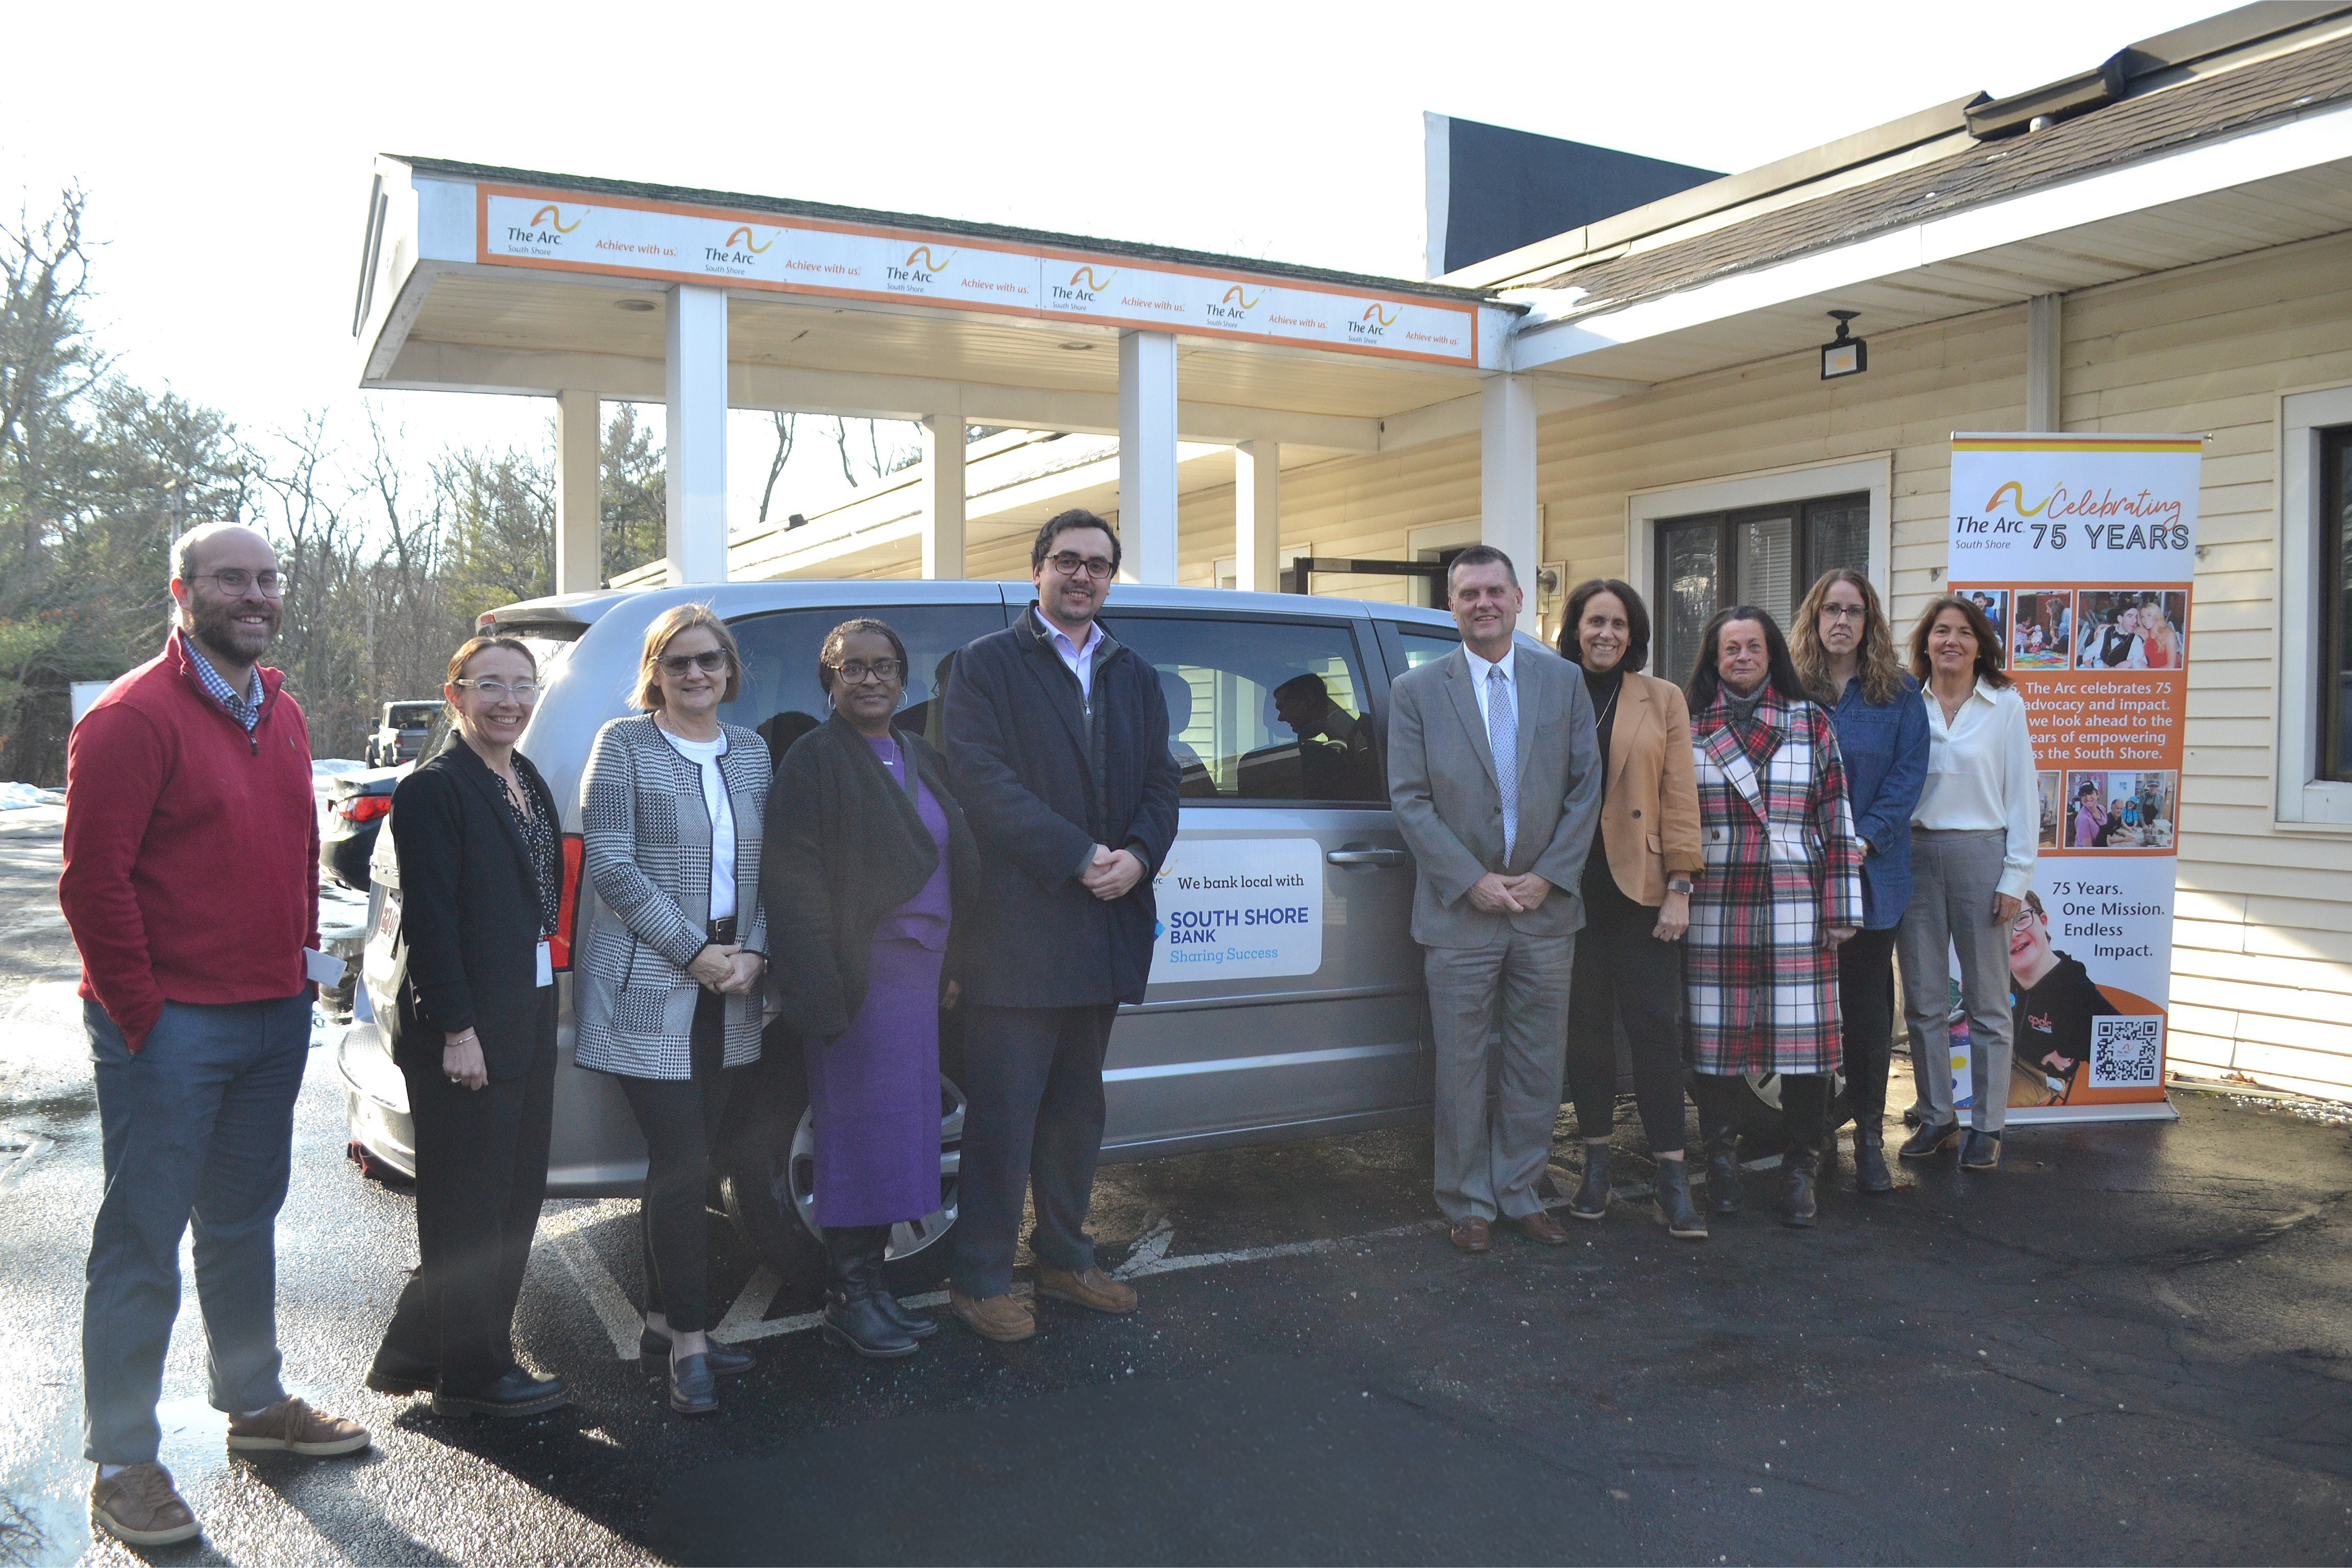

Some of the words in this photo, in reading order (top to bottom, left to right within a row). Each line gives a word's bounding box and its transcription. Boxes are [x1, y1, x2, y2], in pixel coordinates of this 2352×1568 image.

[507, 227, 534, 242] The
[508, 245, 528, 254] South
[531, 247, 551, 255] Shore
[596, 239, 634, 253] Achieve
[638, 243, 660, 255] with
[705, 248, 729, 262] The
[705, 264, 724, 273] South
[726, 266, 745, 275] Shore
[785, 259, 822, 272] Achieve
[824, 263, 846, 274] with
[887, 267, 909, 280] The
[906, 284, 924, 292] Shore
[961, 278, 994, 289] Achieve
[996, 281, 1016, 291] with
[1052, 286, 1072, 299] The
[1121, 297, 1152, 308] Achieve
[1154, 300, 1172, 310] with
[1207, 304, 1225, 316] The
[1269, 314, 1297, 326] Achieve
[1299, 318, 1316, 327] with
[1348, 321, 1365, 333] The
[1406, 331, 1431, 342] Achieve
[1433, 334, 1448, 344] with
[2047, 488, 2182, 532] Celebrating
[1956, 516, 1989, 533] The
[2030, 524, 2067, 549] 75
[2085, 524, 2189, 549] YEARS
[1956, 540, 1983, 549] South
[1985, 540, 2011, 549] Shore
[2026, 682, 2050, 694] The
[2054, 683, 2076, 694] Arc
[2080, 682, 2151, 694] celebrates
[2156, 682, 2171, 693] 75
[2024, 698, 2084, 713] advocacy
[2089, 699, 2115, 710] and
[2120, 698, 2169, 713] impact.
[2029, 716, 2048, 726] we
[2052, 715, 2080, 726] look
[2086, 715, 2128, 726] ahead
[2132, 717, 2147, 726] to
[2151, 715, 2172, 726] the
[2030, 733, 2056, 743] ears
[2061, 731, 2074, 743] of
[2078, 731, 2166, 746] empowering
[2048, 747, 2069, 759] the
[2074, 747, 2114, 759] South
[2119, 747, 2162, 759] Shore.
[1178, 877, 1200, 889] We
[1204, 876, 1238, 889] bank
[1241, 875, 1272, 888] local
[1276, 874, 1304, 887] with
[2052, 882, 2070, 895] 75
[2077, 882, 2123, 895] Years.
[2063, 903, 2095, 915] One
[2101, 902, 2164, 916] Mission.
[1171, 910, 1238, 928] SOUTH
[1245, 908, 1308, 925] SHORE
[2064, 923, 2123, 936] Endless
[1171, 929, 1216, 944] BANK
[1170, 949, 1223, 964] Sharing
[1227, 948, 1278, 961] Success
[2094, 944, 2152, 960] Impact.
